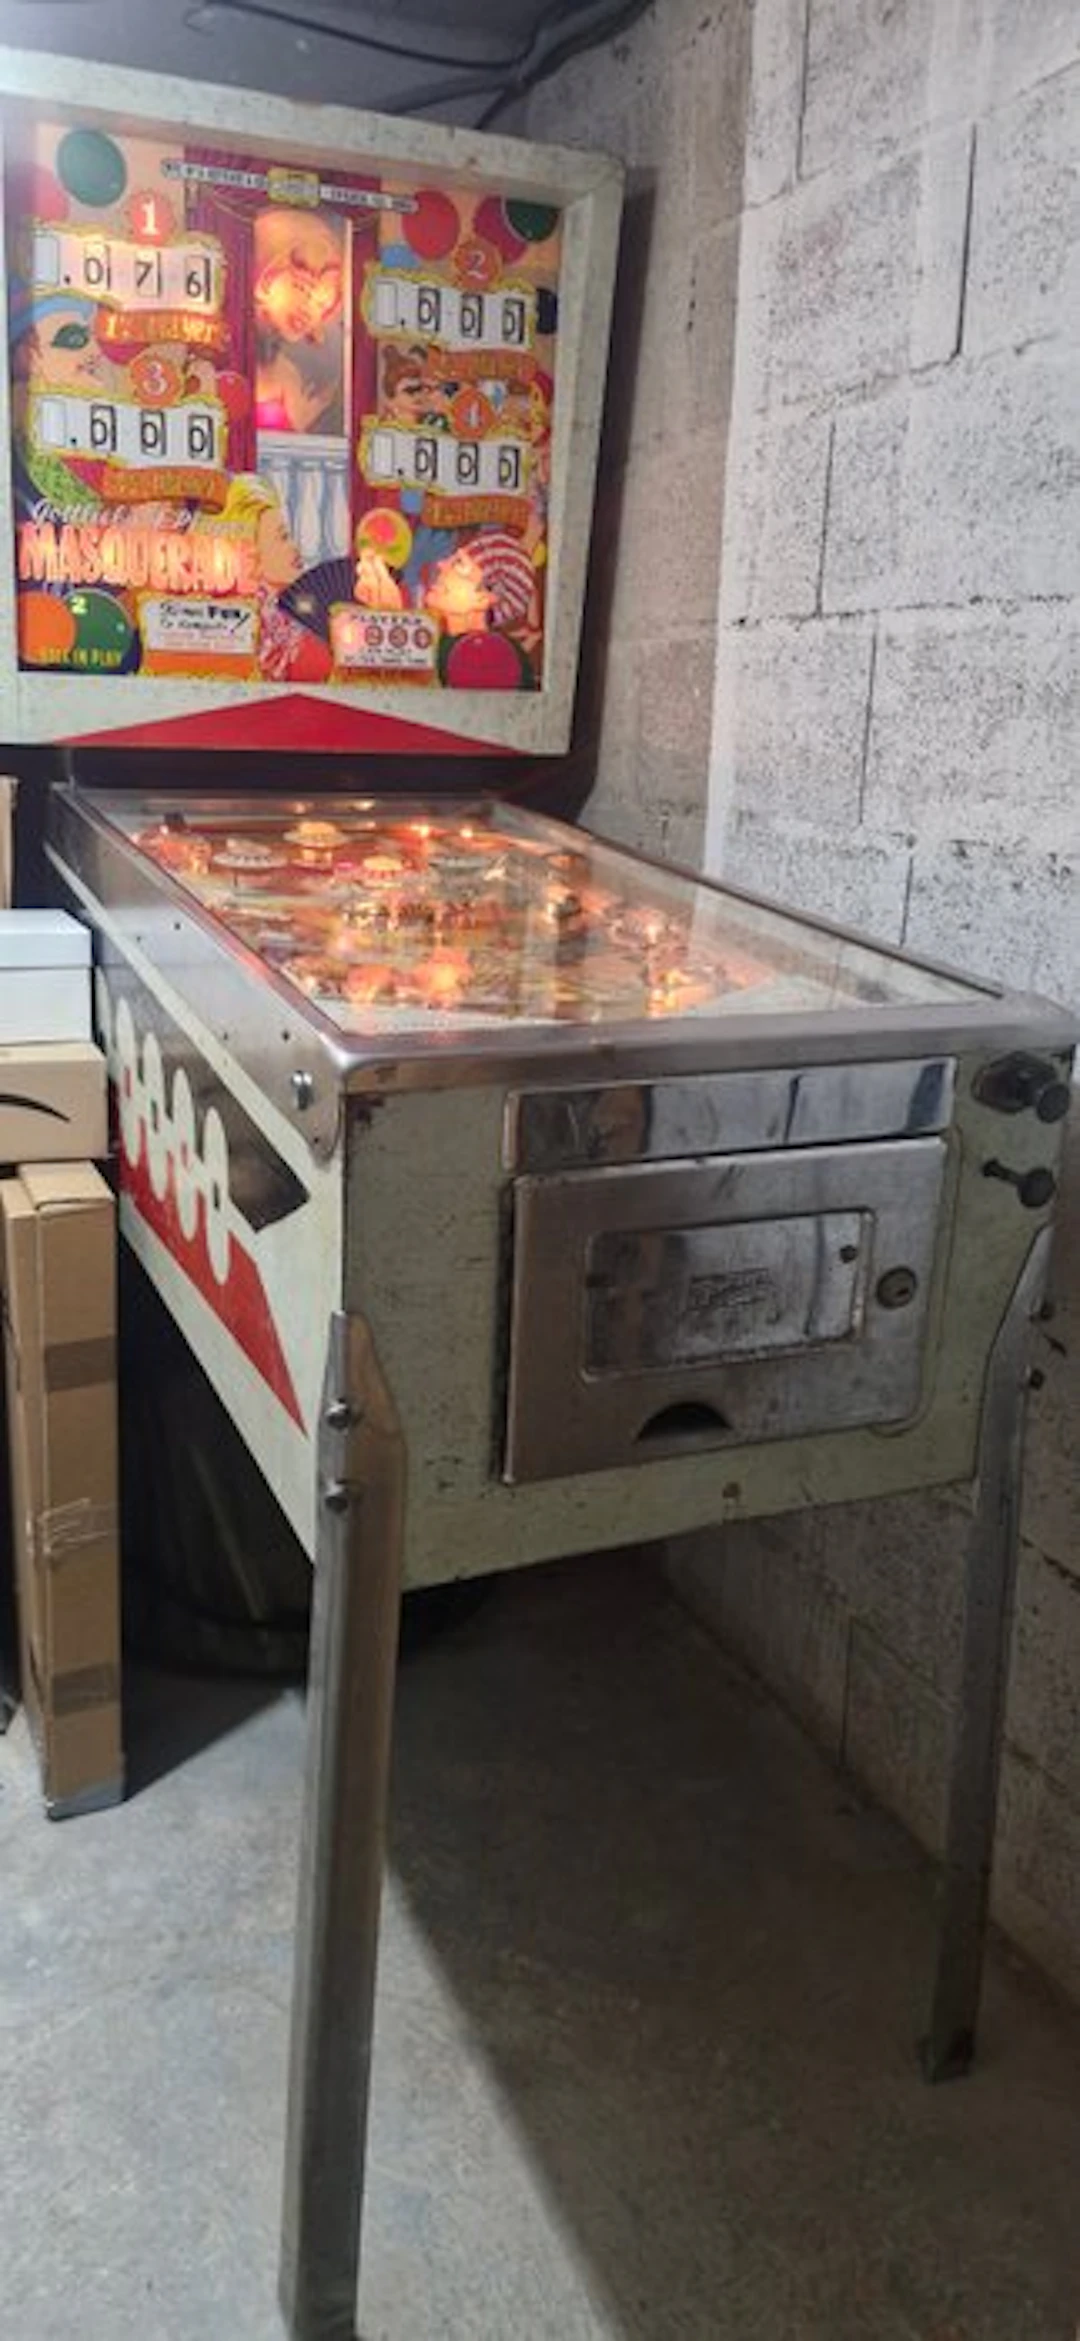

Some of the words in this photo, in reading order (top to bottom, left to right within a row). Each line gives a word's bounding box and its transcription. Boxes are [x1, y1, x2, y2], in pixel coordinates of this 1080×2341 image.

[141, 201, 160, 236] 1
[468, 252, 487, 280] 2
[145, 362, 168, 394] 3
[463, 406, 482, 427] 4
[18, 520, 259, 597] MASQUERADE
[70, 595, 88, 615] 2
